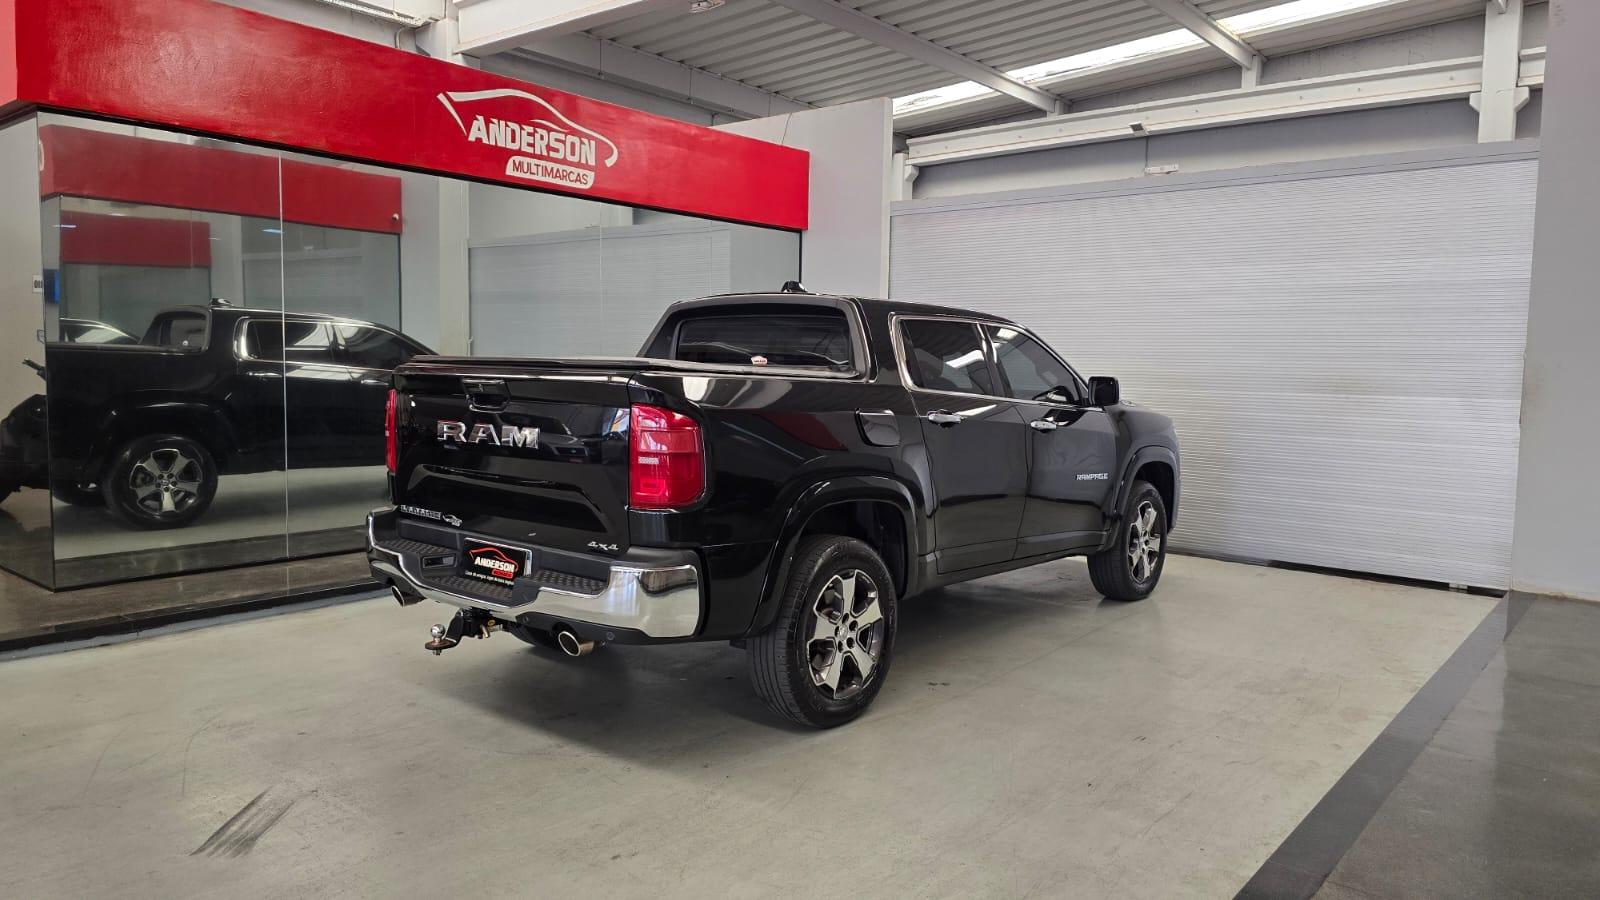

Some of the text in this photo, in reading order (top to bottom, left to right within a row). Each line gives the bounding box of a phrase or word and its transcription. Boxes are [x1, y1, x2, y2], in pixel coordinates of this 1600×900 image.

[467, 114, 596, 166] ANDERSON
[512, 159, 589, 185] MULTIMARCAS
[437, 420, 540, 449] RAM
[474, 556, 515, 573] ANDERSON
